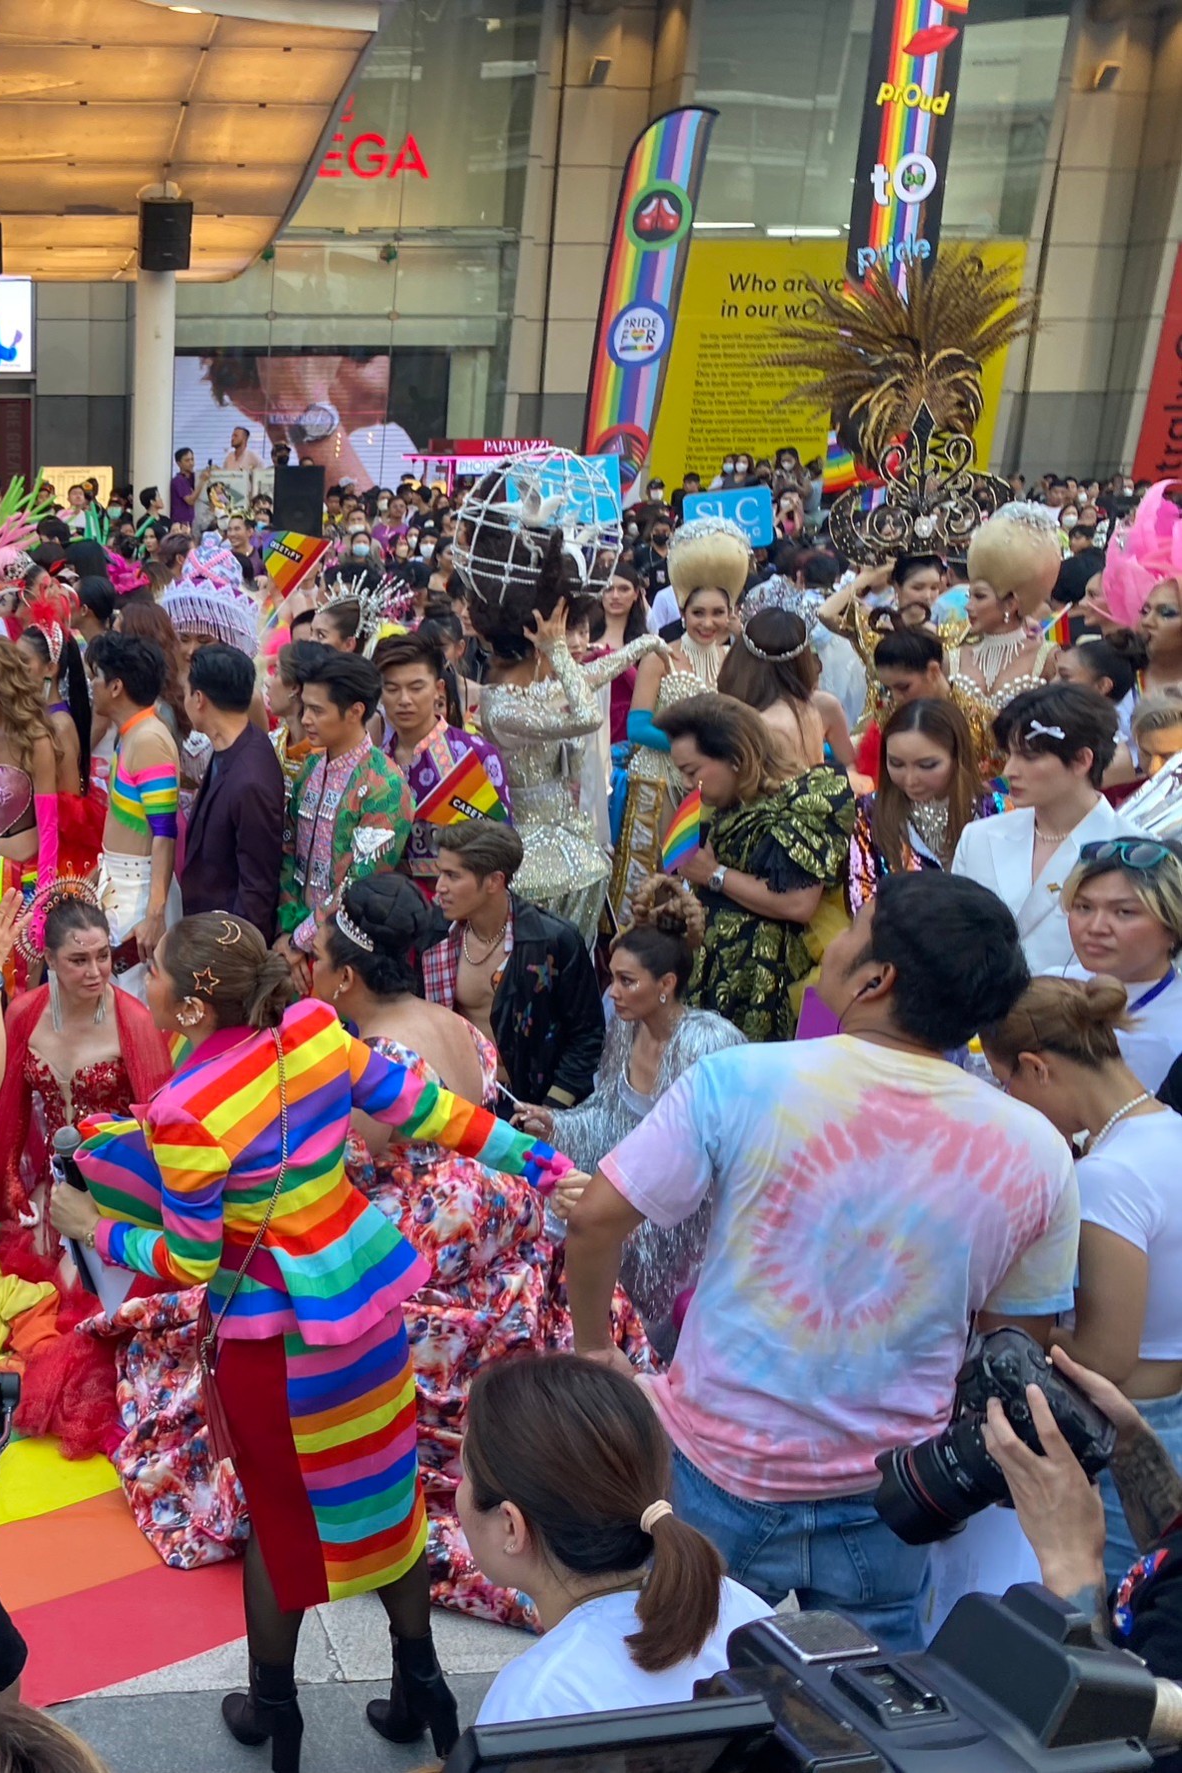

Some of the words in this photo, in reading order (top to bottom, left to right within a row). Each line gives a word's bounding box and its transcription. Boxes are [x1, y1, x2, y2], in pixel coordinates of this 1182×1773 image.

[876, 82, 951, 116] prOud
[317, 132, 429, 180] EGA
[729, 273, 777, 293] Who
[720, 299, 739, 318] in
[745, 303, 779, 318] our
[623, 316, 659, 330] PRIDE
